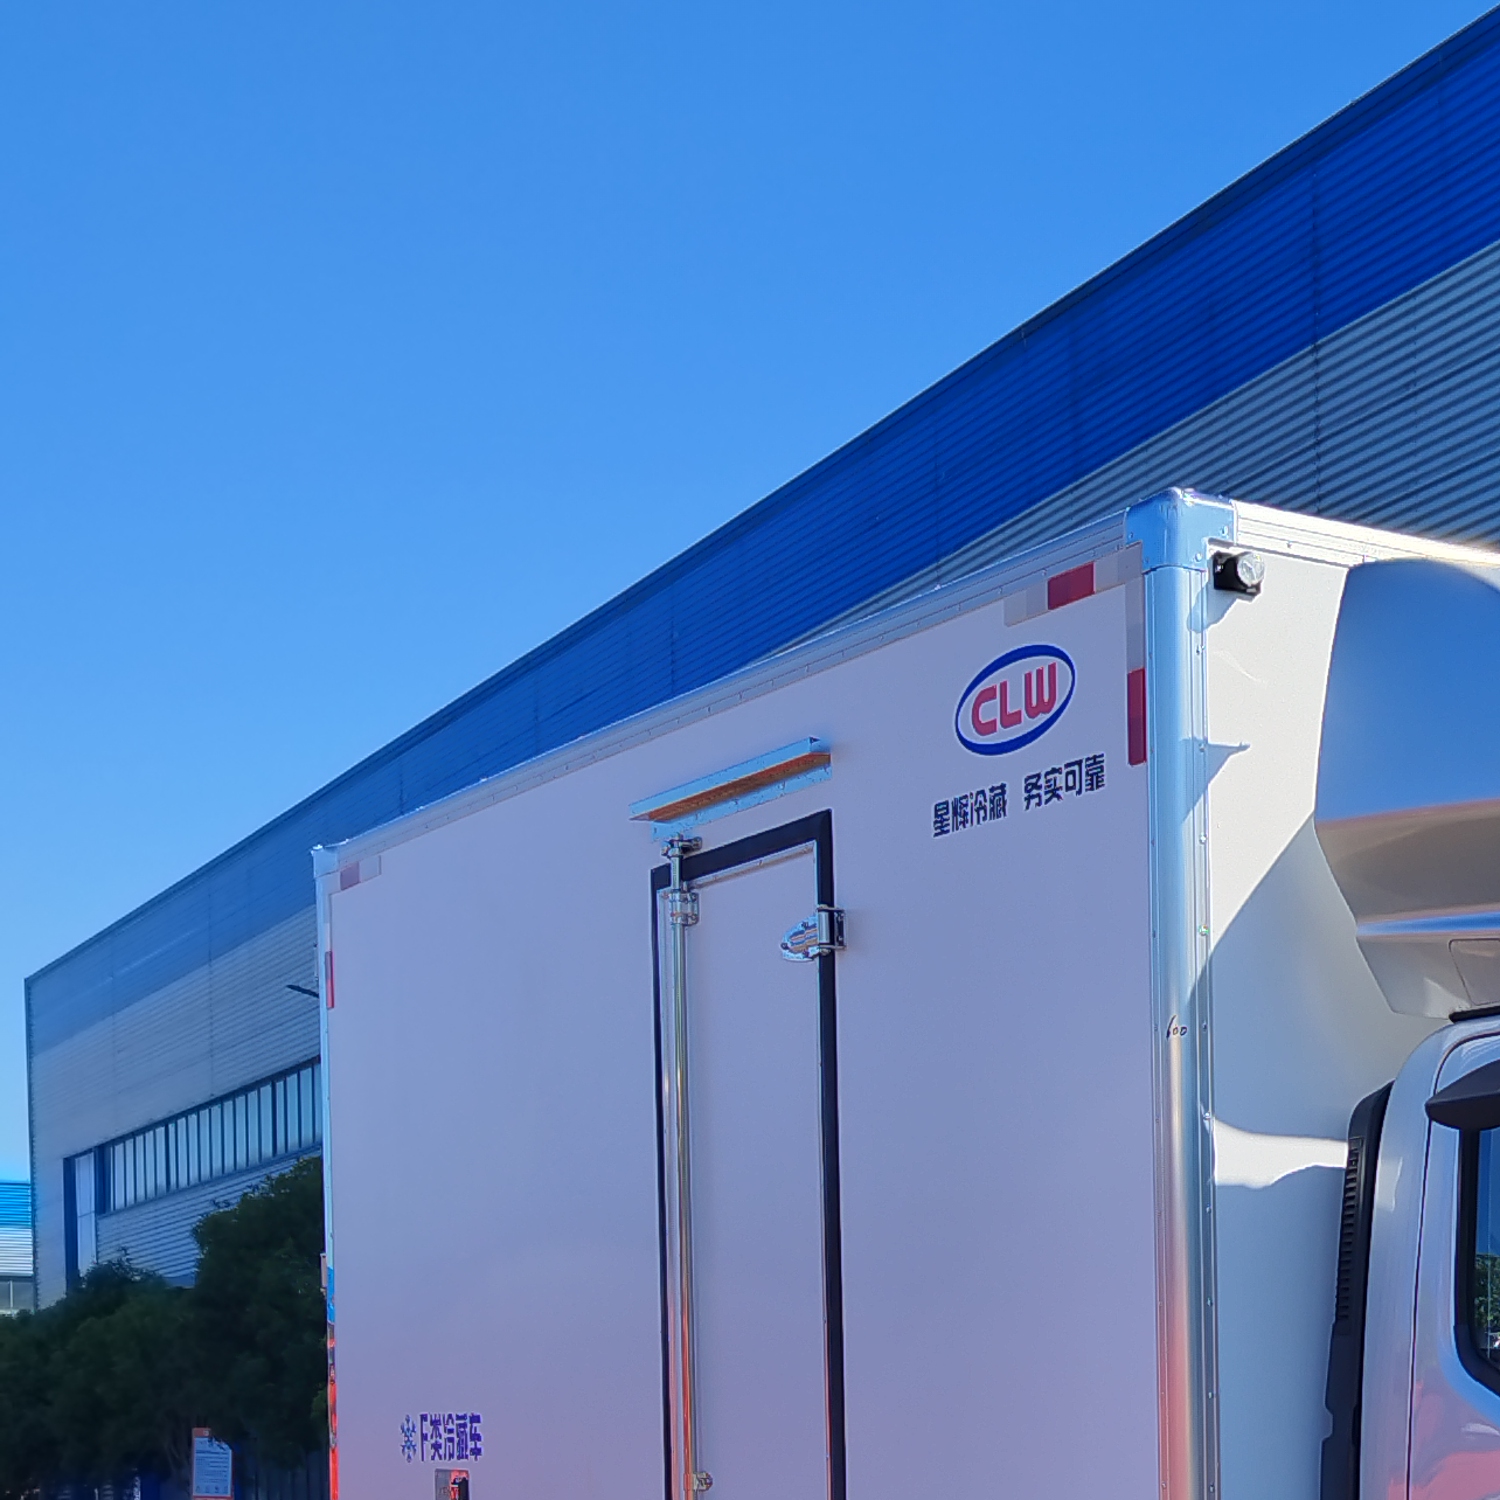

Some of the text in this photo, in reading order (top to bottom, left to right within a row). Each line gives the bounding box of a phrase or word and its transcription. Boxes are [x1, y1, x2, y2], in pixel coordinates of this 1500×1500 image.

[971, 661, 1057, 737] CLW
[932, 752, 1106, 838] 星辉冷藏 务实可靠
[419, 1412, 482, 1462] F类冷藏车
